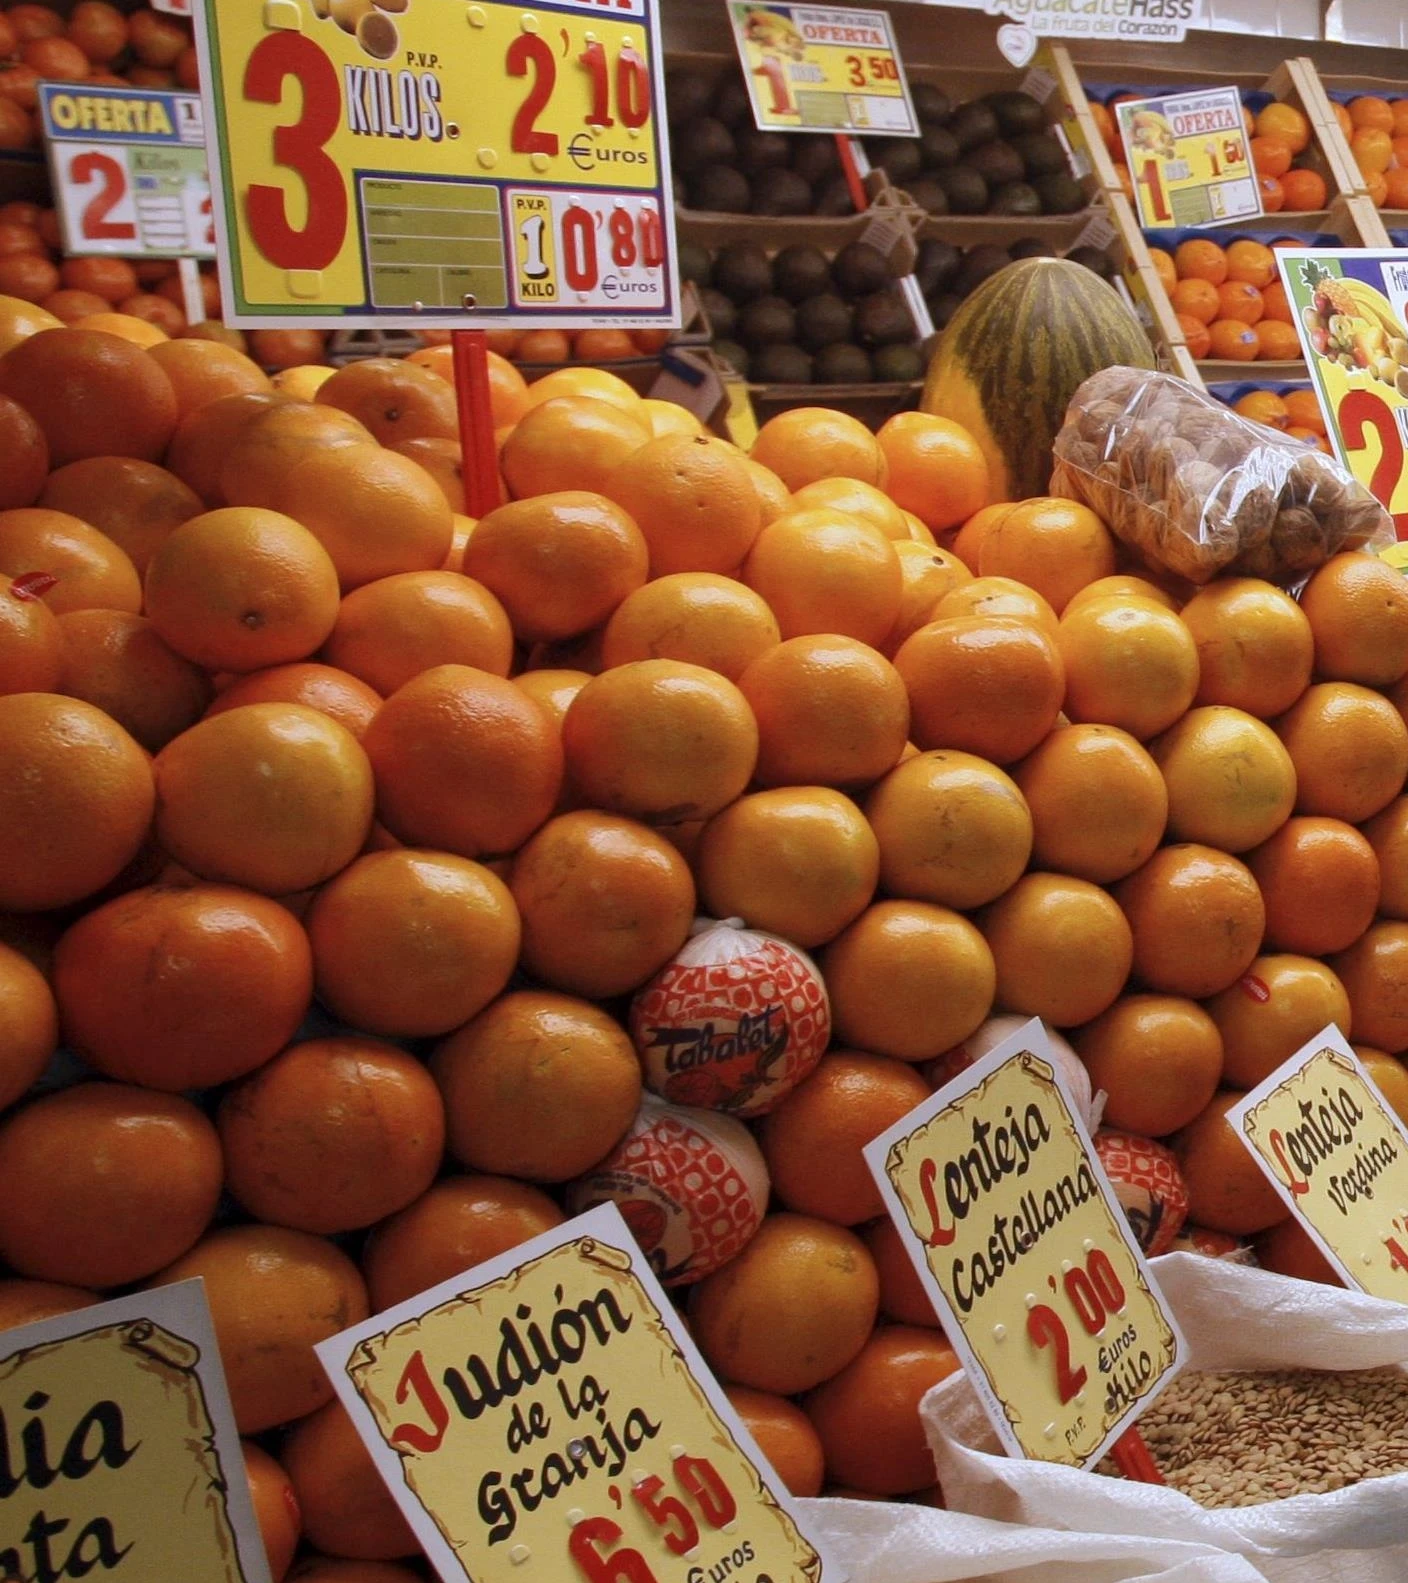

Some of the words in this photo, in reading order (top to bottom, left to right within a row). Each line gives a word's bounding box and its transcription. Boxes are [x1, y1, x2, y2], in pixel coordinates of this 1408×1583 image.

[406, 51, 443, 69] P.V.P.
[803, 23, 883, 45] OFERTA
[51, 94, 174, 135] OFERTA
[505, 28, 651, 157] 2'10
[752, 55, 798, 115] 1
[1172, 109, 1237, 135] OFERTA
[242, 31, 348, 271] 3
[344, 64, 444, 143] KILOS
[1135, 159, 1172, 222] 1
[69, 150, 137, 240] 2
[516, 198, 547, 211] P.V.P.
[519, 214, 550, 280] 1
[561, 205, 663, 292] 0'80
[521, 282, 556, 298] KILO
[647, 1004, 789, 1074] Tabalet
[918, 1101, 1052, 1249] Lenteja
[1268, 1085, 1364, 1201] Lenteja
[952, 1155, 1099, 1315] Castellana
[1025, 1247, 1127, 1407] 2'00
[392, 1283, 634, 1454] Judión
[506, 1399, 552, 1456] de
[556, 1374, 610, 1422] la
[475, 1402, 663, 1548] Granja
